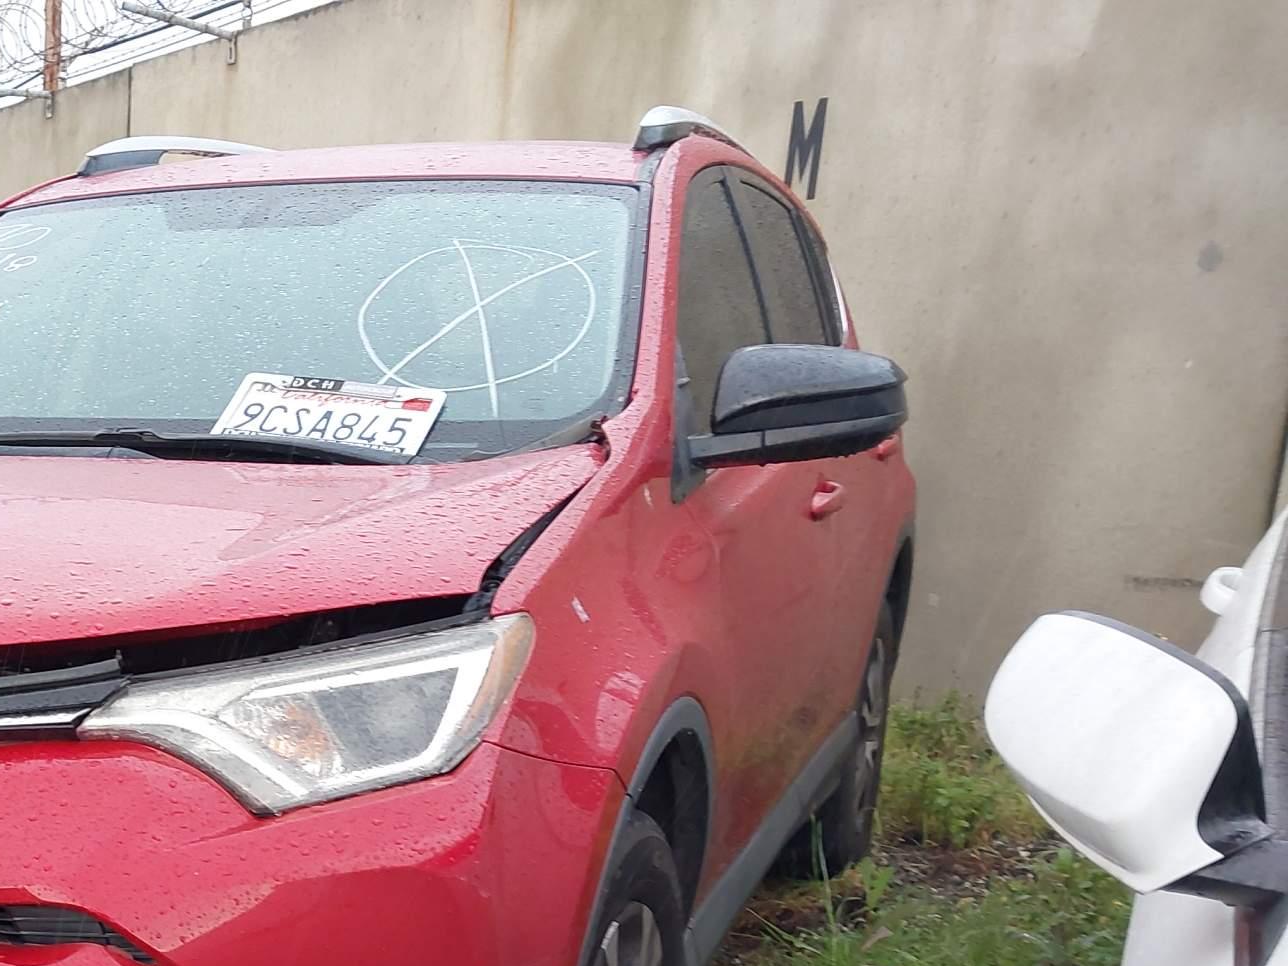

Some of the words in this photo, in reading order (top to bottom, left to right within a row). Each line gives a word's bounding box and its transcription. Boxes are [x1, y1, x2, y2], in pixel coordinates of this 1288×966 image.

[784, 97, 829, 200] M
[292, 378, 335, 391] DCH
[233, 403, 412, 446] 9CSA845
